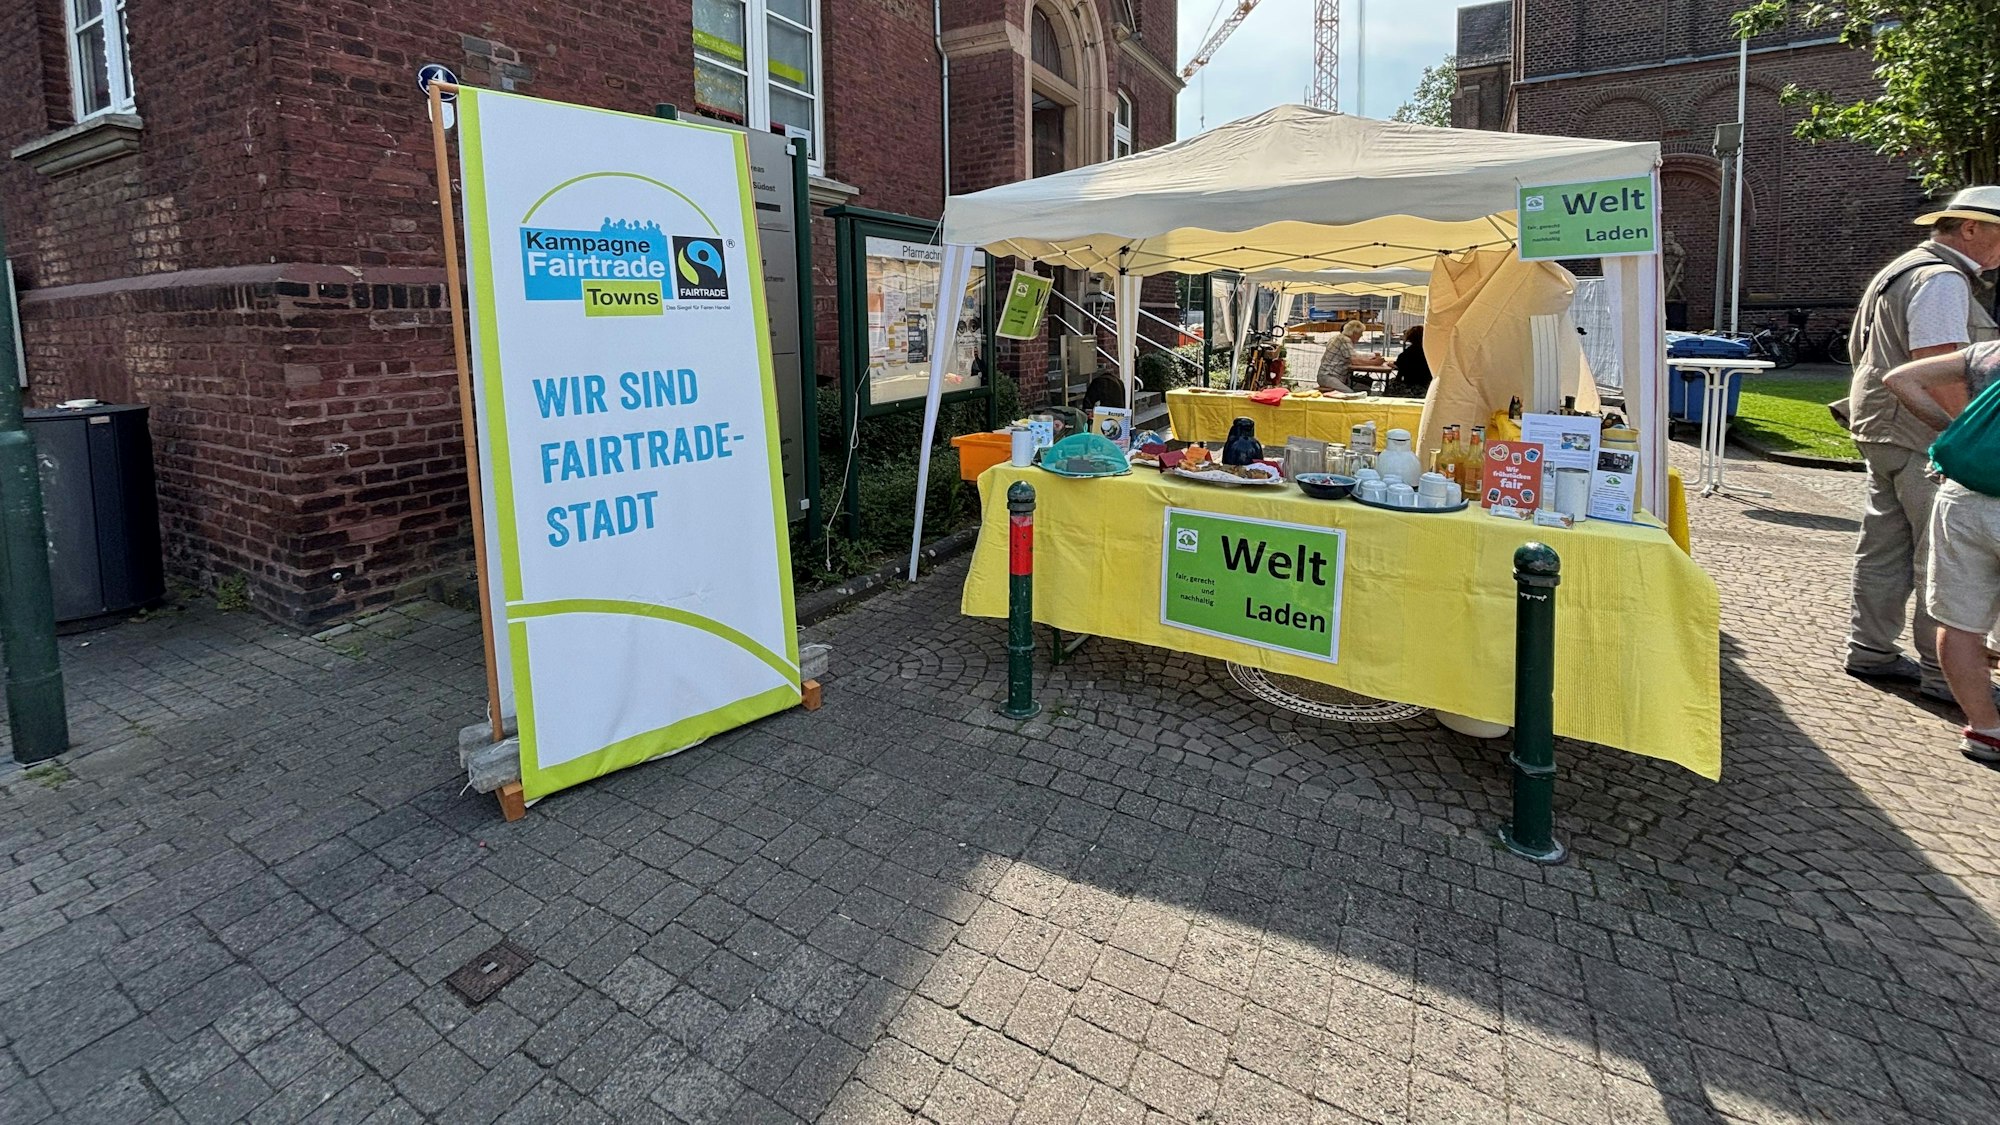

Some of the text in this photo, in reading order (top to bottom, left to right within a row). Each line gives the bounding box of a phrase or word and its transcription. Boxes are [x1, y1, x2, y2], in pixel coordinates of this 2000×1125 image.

[752, 181, 776, 192] Südost
[1562, 187, 1645, 216] Welt
[526, 231, 651, 257] Kampagne
[1585, 226, 1648, 242] Laden
[527, 251, 666, 278] Fairtrade
[586, 288, 659, 306] Towns
[680, 288, 726, 297] FAIRTRADE
[532, 368, 698, 419] WIR SIND
[540, 422, 744, 484] FAIRTRADE-
[1500, 478, 1523, 489] fair
[546, 490, 658, 548] STADT
[1221, 535, 1327, 586] Welt
[1175, 572, 1215, 586] fair, gerecht
[1180, 594, 1215, 607] nachhaltig
[1201, 588, 1215, 596] und
[1245, 597, 1325, 633] Laden
